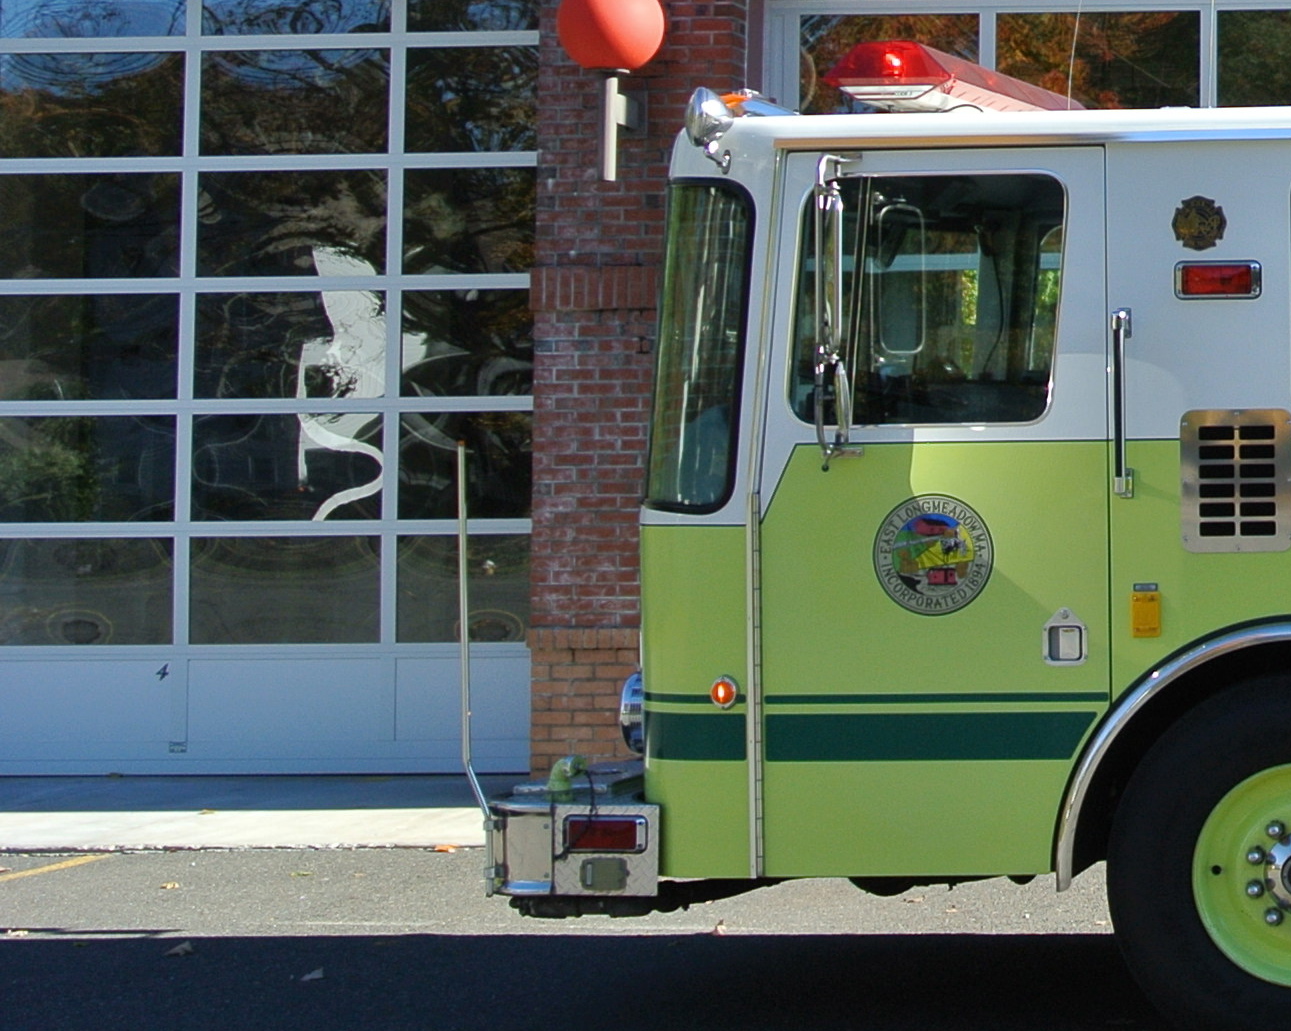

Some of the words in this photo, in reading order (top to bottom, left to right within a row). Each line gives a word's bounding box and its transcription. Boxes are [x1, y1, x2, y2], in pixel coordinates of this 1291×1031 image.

[880, 521, 899, 555] EAST
[898, 500, 981, 533] LONGMEADOW
[974, 530, 987, 553] MA
[880, 563, 968, 609] INCORPORATED
[968, 563, 987, 591] 1894
[155, 663, 169, 681] 4
